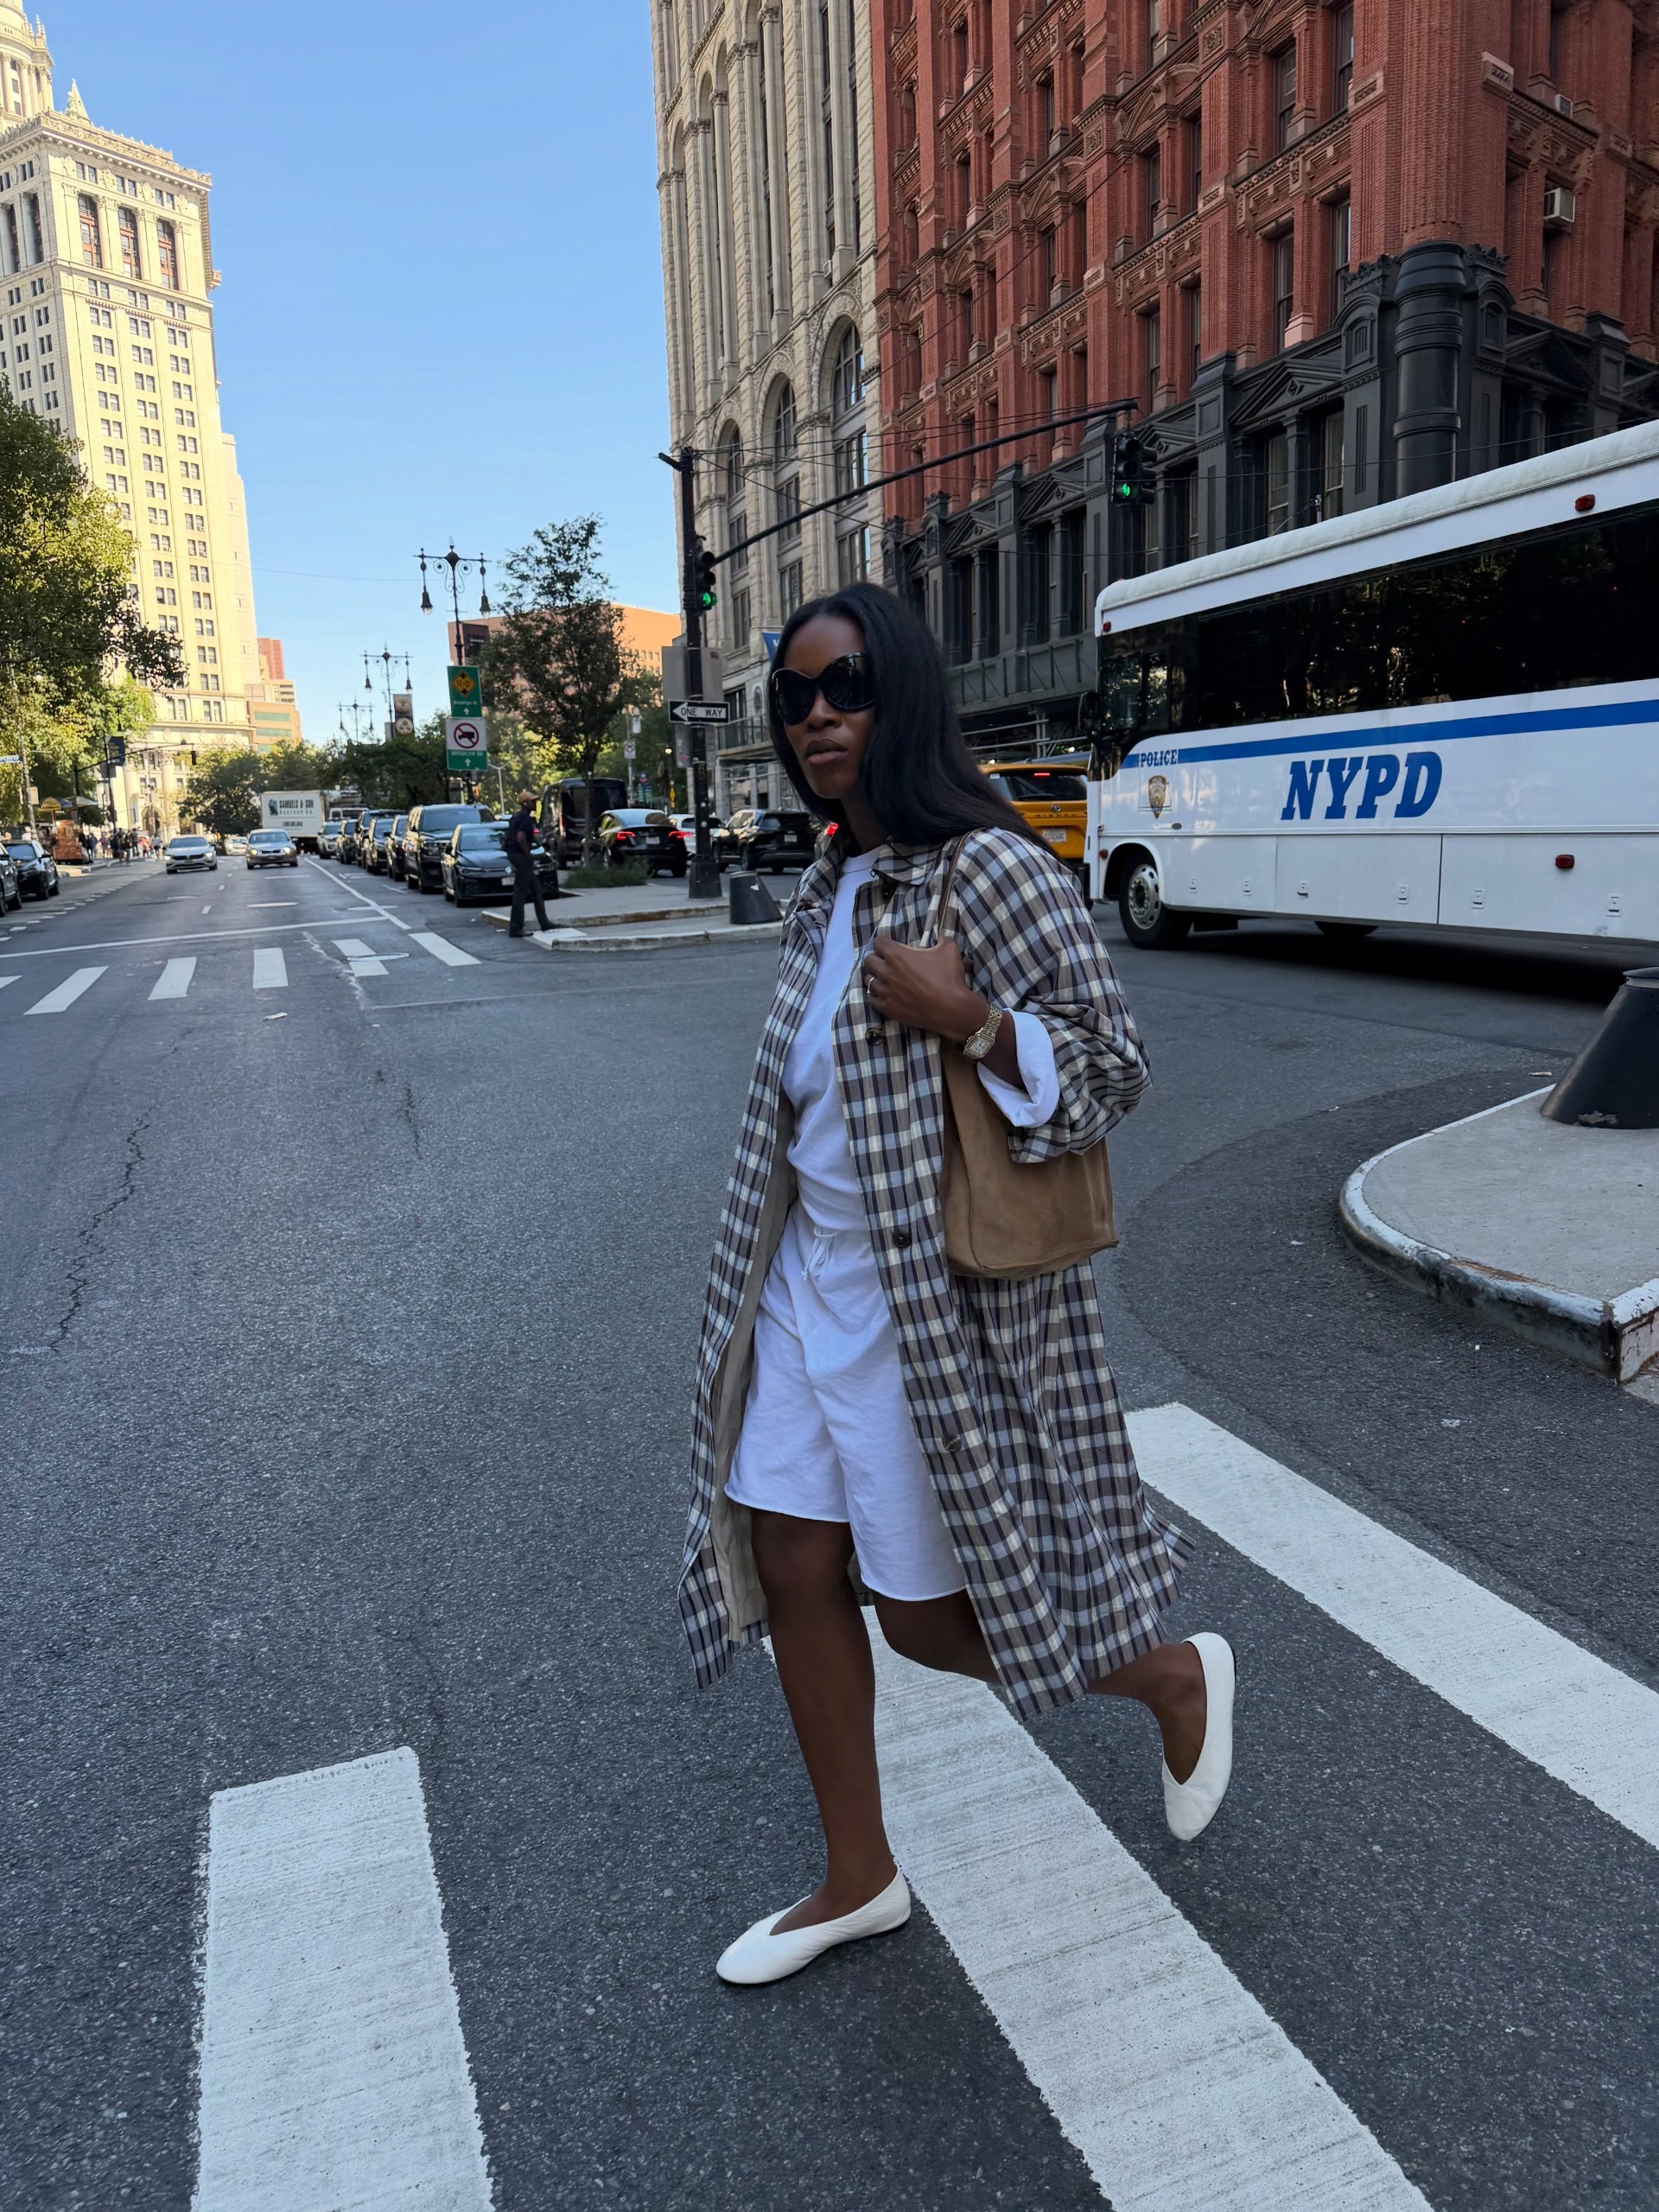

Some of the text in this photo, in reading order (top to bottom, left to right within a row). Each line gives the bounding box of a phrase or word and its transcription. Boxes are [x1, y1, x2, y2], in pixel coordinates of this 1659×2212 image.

[681, 708, 723, 717] ONE WAY
[1141, 749, 1177, 767] POLICE
[1281, 751, 1442, 820] NYPD
[279, 799, 298, 809] SAMUELS
